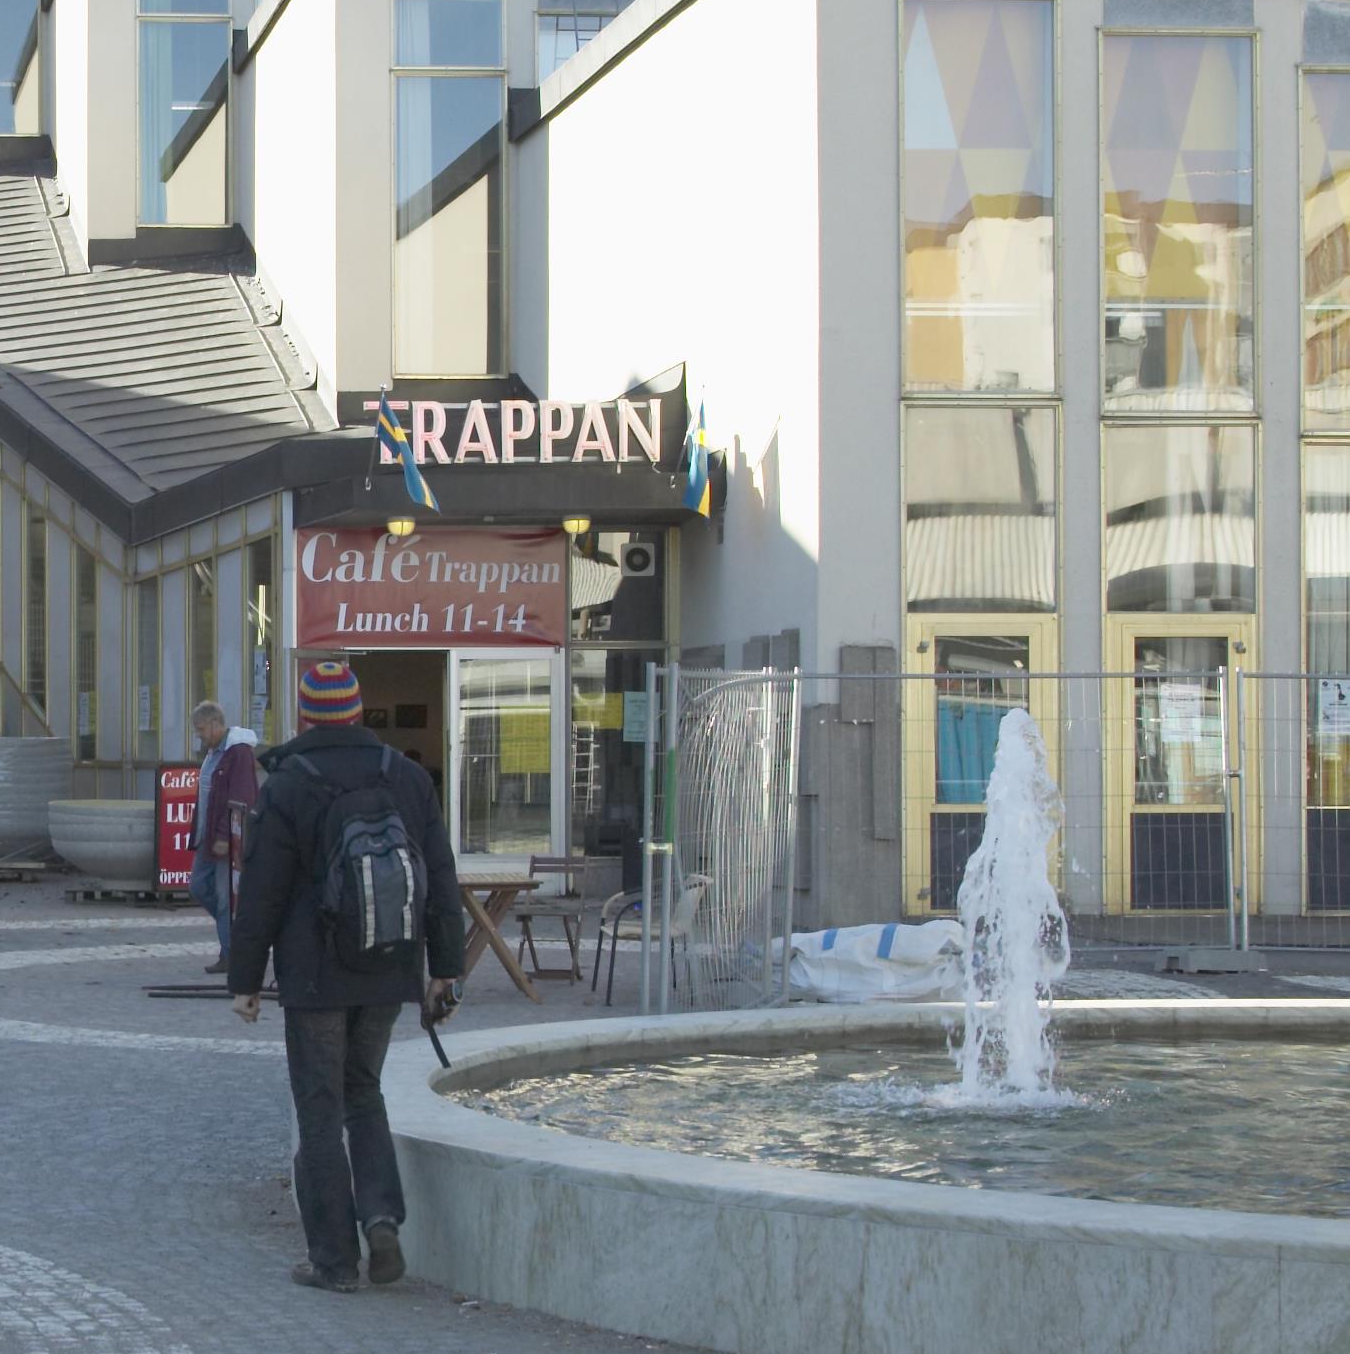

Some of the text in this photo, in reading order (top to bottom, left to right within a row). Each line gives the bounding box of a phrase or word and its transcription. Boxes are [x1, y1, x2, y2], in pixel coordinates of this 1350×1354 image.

[363, 399, 661, 464] TRAPPAN
[301, 532, 561, 593] Café Trappan
[336, 603, 528, 633] Lunch 11-14
[160, 771, 196, 788] Café
[159, 868, 194, 884] ÖPPE
